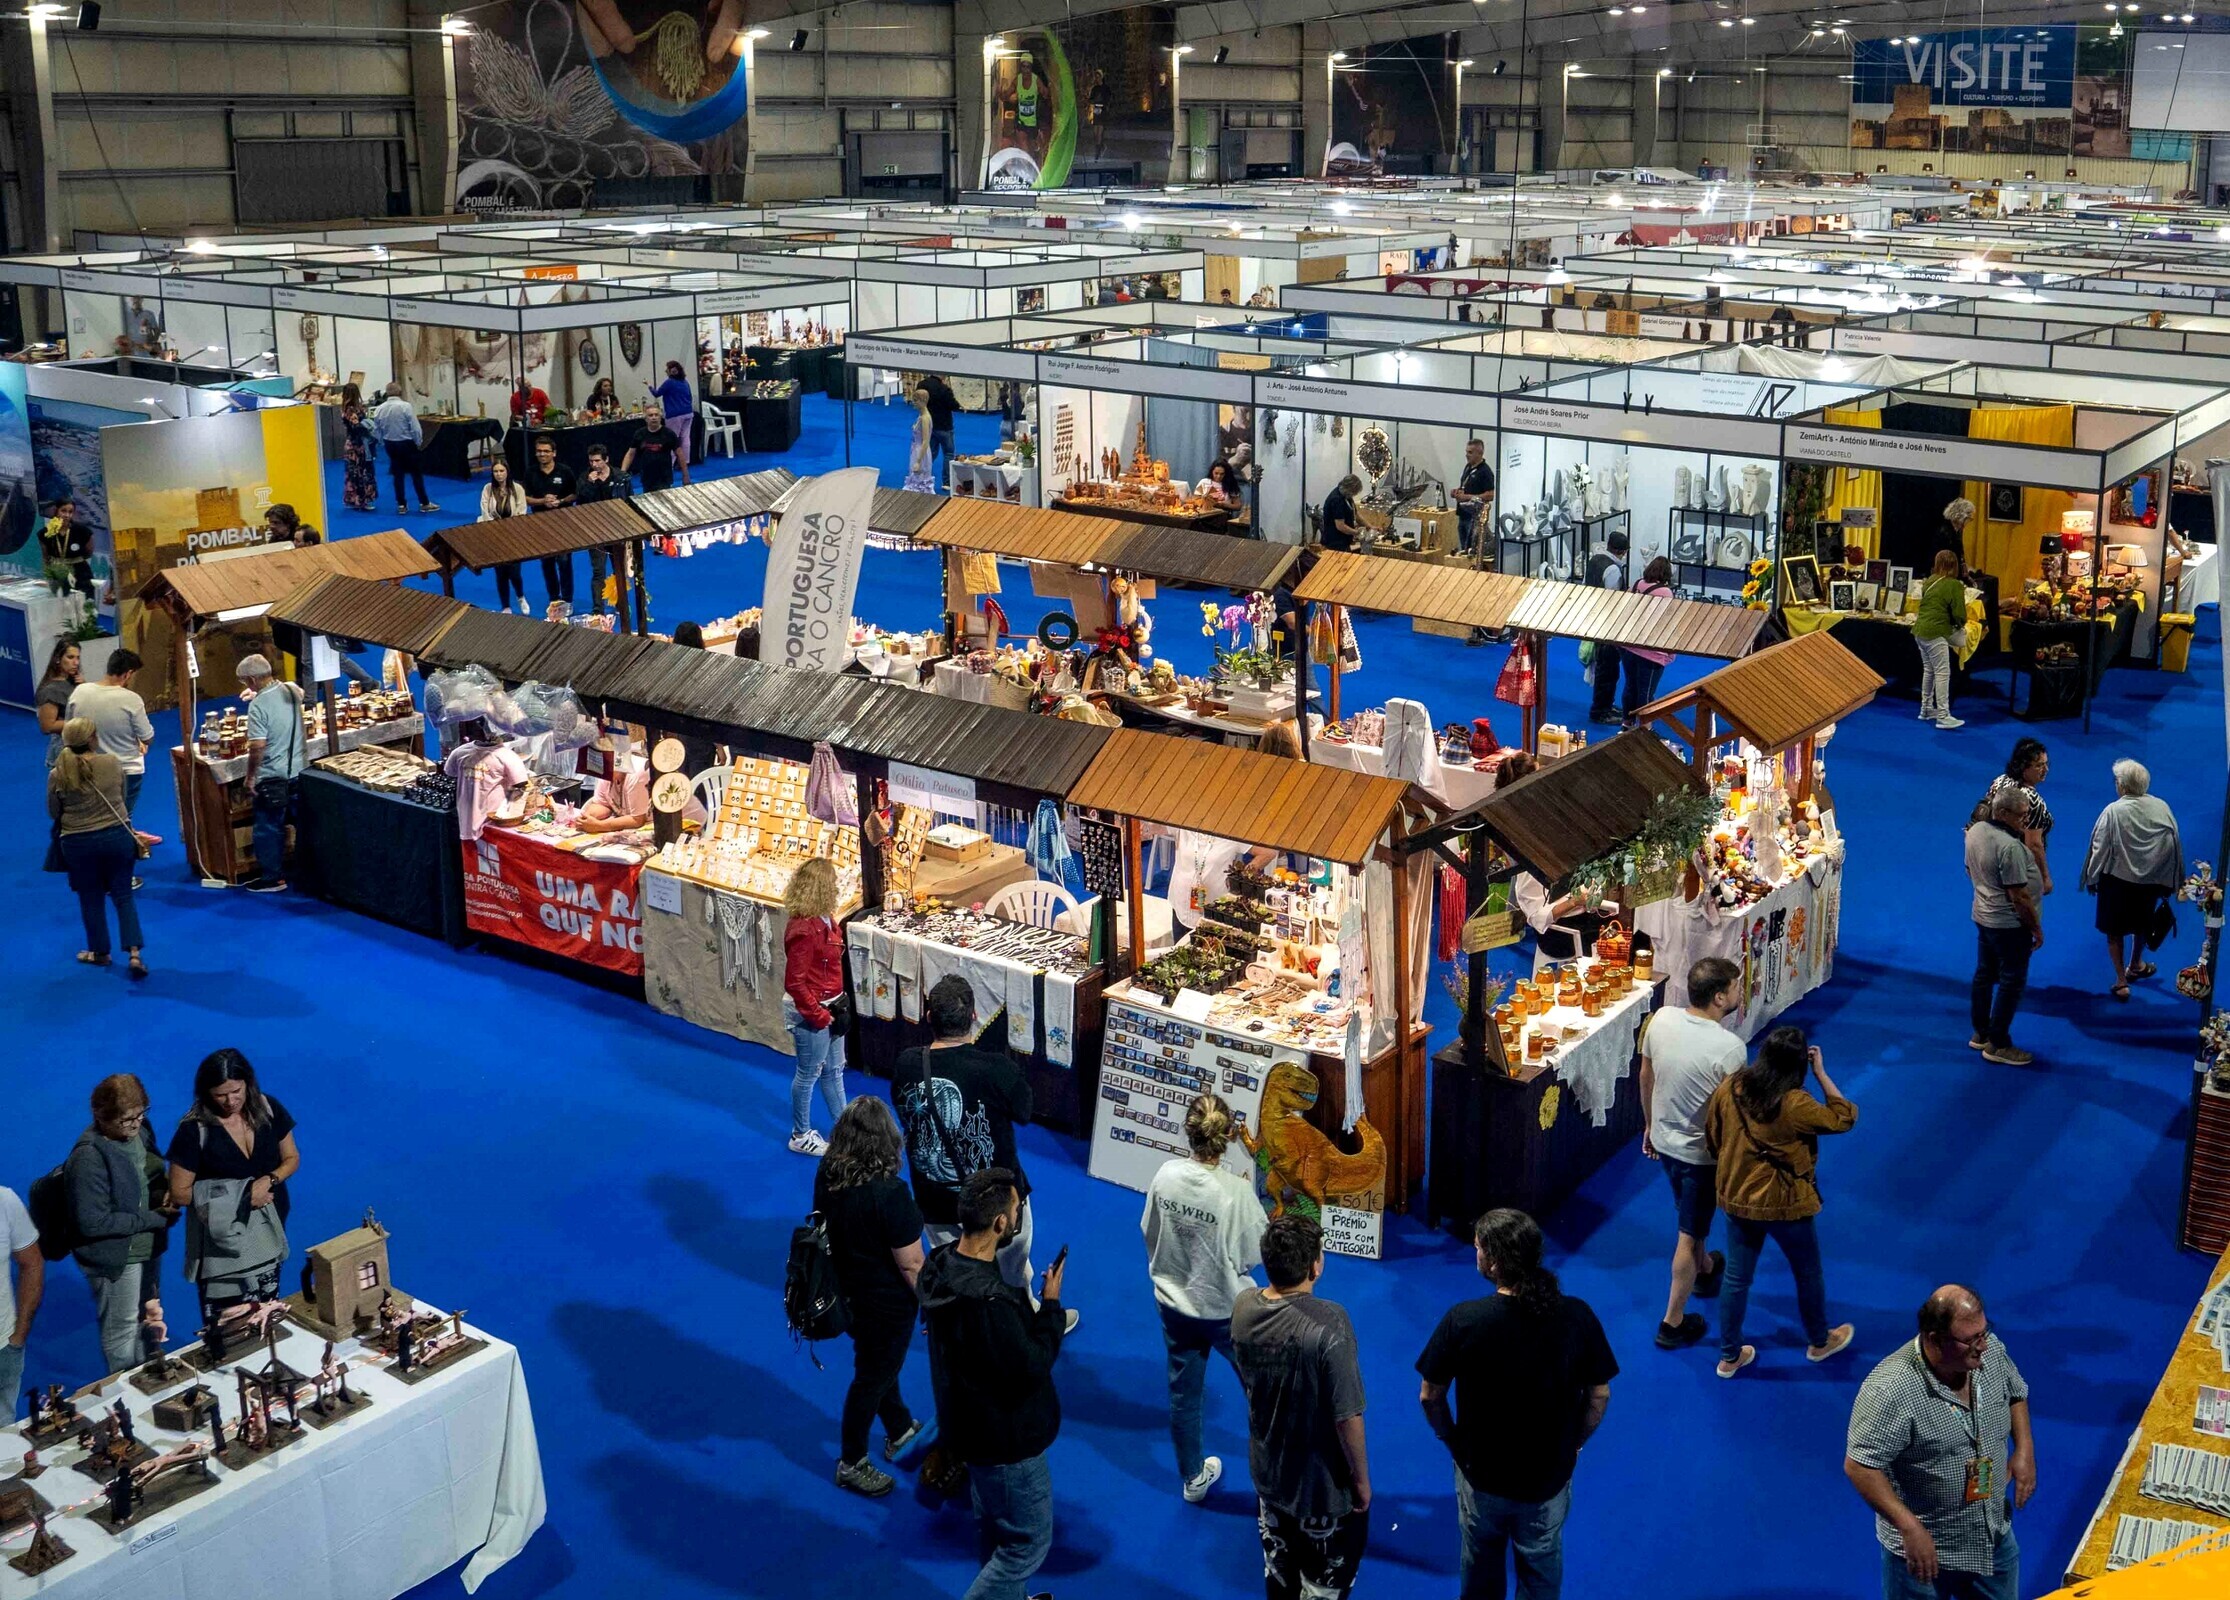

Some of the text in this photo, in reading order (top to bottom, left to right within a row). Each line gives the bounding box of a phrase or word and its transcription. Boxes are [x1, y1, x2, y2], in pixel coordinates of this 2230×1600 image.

[1902, 42, 2048, 91] VISITE
[1991, 94, 2014, 102] TURISMO
[465, 196, 505, 207] POMBAL
[1641, 316, 1682, 327] Gabriel Gonçalves
[1863, 334, 1882, 342] Valente
[874, 345, 881, 353] de
[881, 344, 889, 353] Vila
[906, 346, 920, 356] Marca
[920, 348, 939, 358] Namorar
[939, 350, 959, 360] Portugal
[1048, 359, 1056, 368] Rui
[1057, 361, 1070, 371] Jorge
[1076, 362, 1094, 371] Amorim
[1095, 364, 1120, 374] Rodrigues
[1272, 382, 1284, 390] Arte
[1287, 383, 1301, 392] José
[1301, 384, 1324, 394] António
[1324, 387, 1348, 396] Antunes
[1513, 404, 1590, 420] José André Soares Prior
[1546, 421, 1562, 429] BEIRA
[1799, 431, 1834, 443] ZemiArt's
[1839, 435, 1868, 446] António
[1869, 438, 1898, 449] Miranda
[1905, 441, 1923, 451] José
[1924, 444, 1947, 454] Neves
[1799, 447, 1852, 459] VIANA DO CASTELO
[187, 525, 262, 551] POMBAL
[813, 514, 845, 614] CANCRO
[785, 512, 823, 668] PORTUGUESA
[809, 619, 829, 641] O
[932, 780, 969, 797] Patusco
[476, 874, 520, 895] PORTUGUESA
[535, 870, 602, 912] UMA
[539, 902, 593, 942] QUE
[1363, 1190, 1384, 1212] 1€
[1327, 1206, 1375, 1219] SAI SEMPRE
[1322, 1227, 1375, 1244] RIFAS COM
[1323, 1238, 1377, 1256] CATEGORIA
